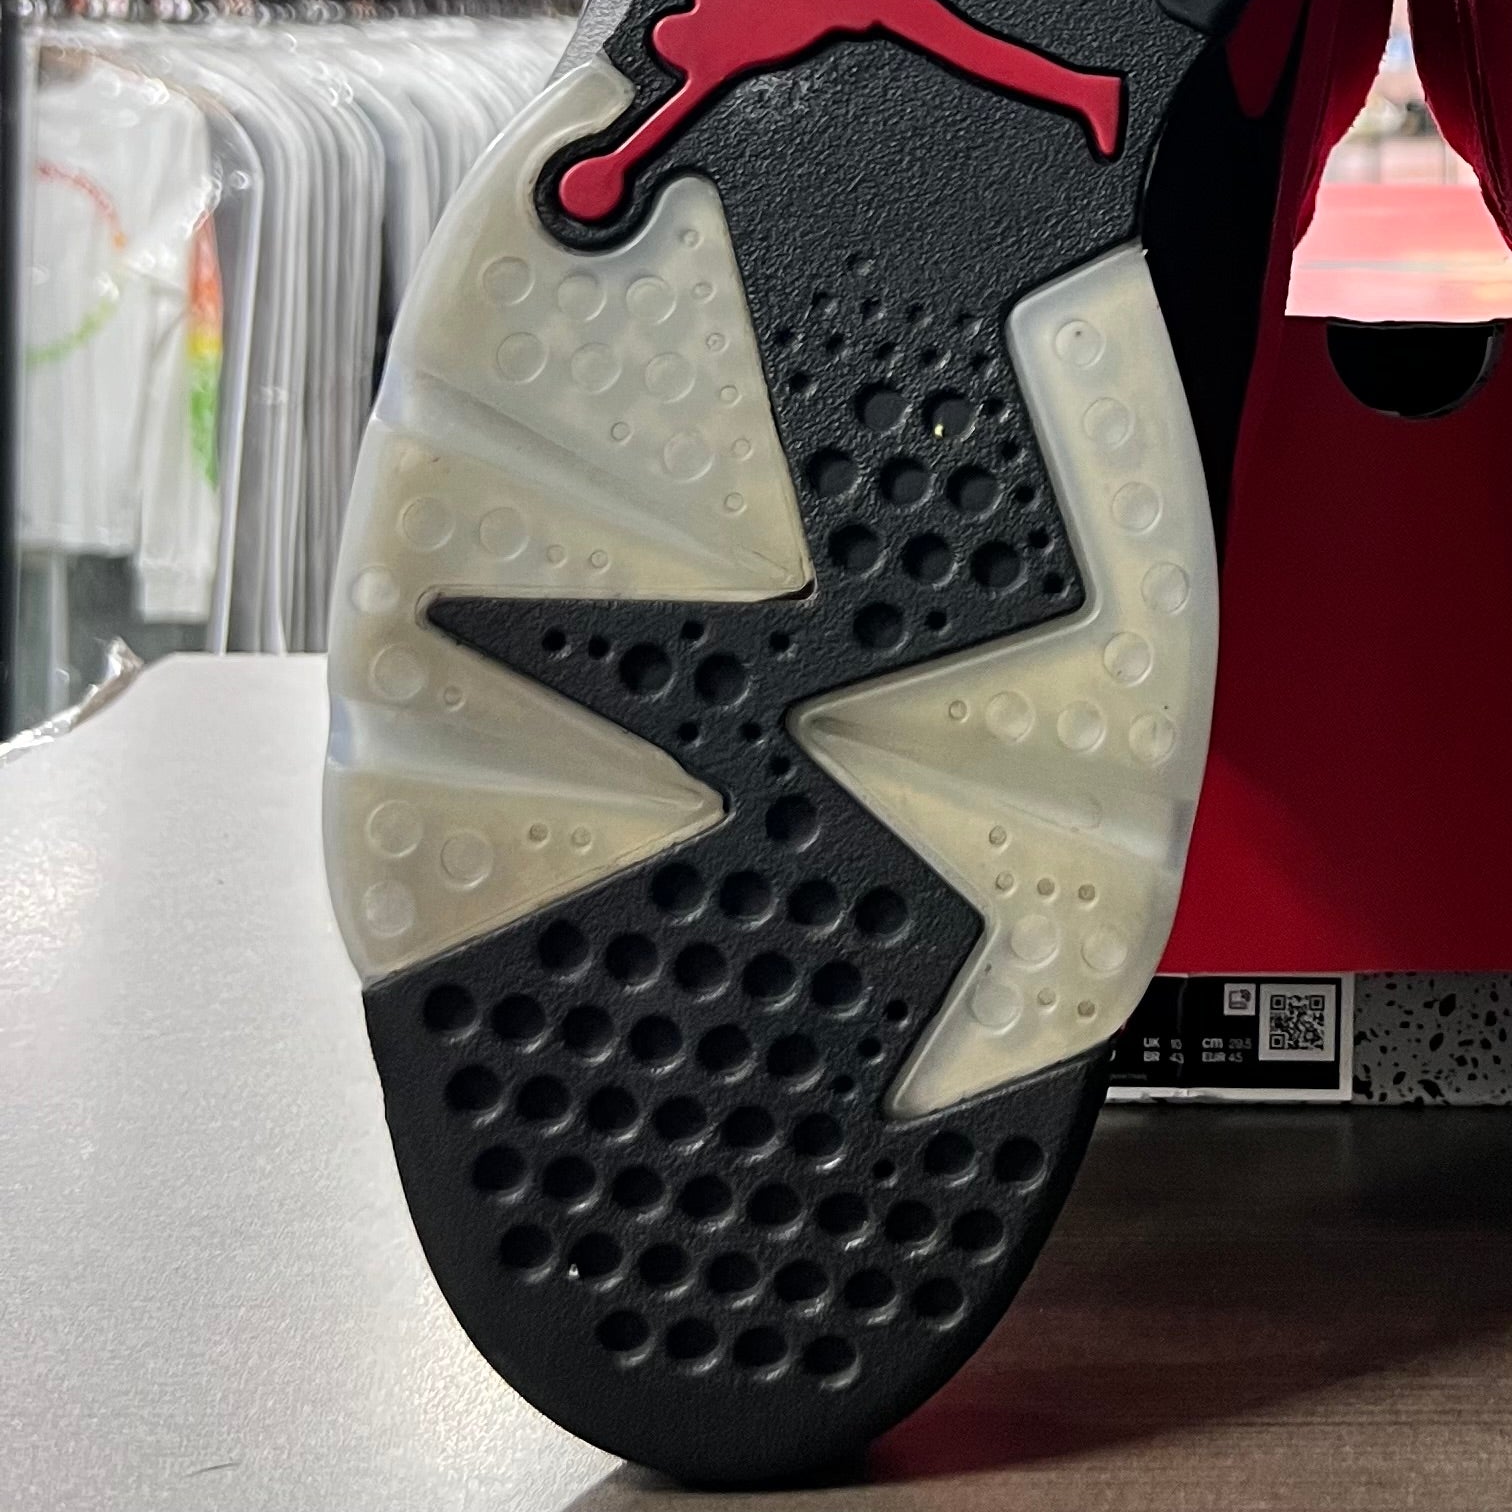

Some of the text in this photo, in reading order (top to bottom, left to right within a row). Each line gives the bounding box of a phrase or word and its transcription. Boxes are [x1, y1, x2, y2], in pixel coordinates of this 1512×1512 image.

[1143, 1037, 1160, 1048] UK
[1201, 1051, 1243, 1063] EUR 45
